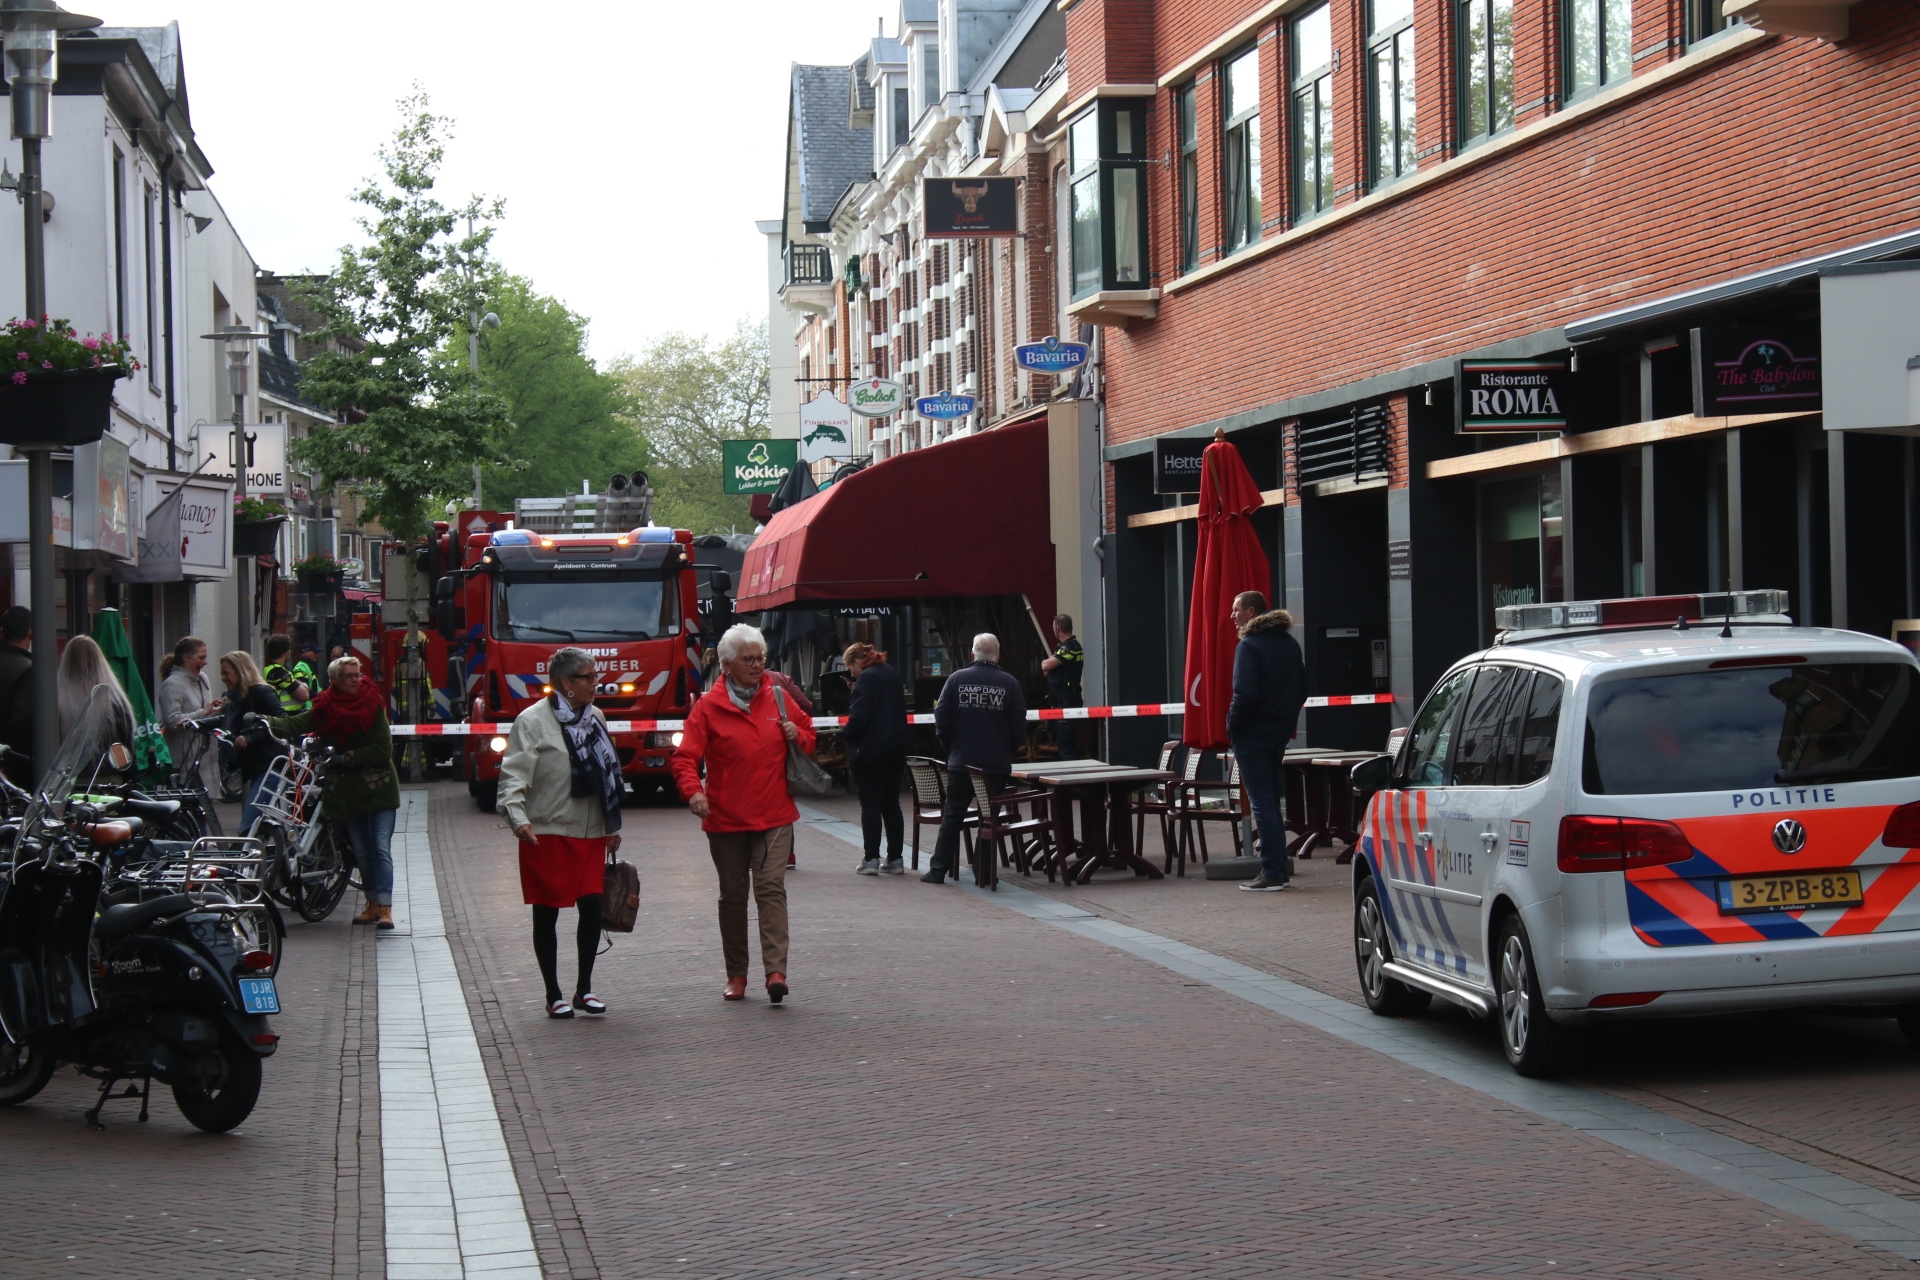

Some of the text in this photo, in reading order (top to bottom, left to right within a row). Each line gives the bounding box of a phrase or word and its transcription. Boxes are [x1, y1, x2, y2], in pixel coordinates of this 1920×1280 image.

[1026, 350, 1080, 364] Bavaria
[1480, 373, 1548, 386] Ristorante
[1718, 364, 1816, 388] The Babylon
[1760, 384, 1776, 392] Club
[855, 388, 896, 406] Grolsch
[1470, 388, 1561, 415] ROMA
[924, 401, 968, 413] Bavaria
[735, 464, 788, 481] Kokkie
[243, 473, 282, 487] HONE
[1493, 583, 1534, 607] Ristorante
[536, 660, 639, 673] BWEER
[959, 692, 1004, 706] CREW
[982, 687, 1006, 697] DAVID
[1732, 788, 1836, 808] POLITIE
[1742, 876, 1850, 904] 3-ZPB-83
[251, 982, 272, 994] DJR
[255, 997, 275, 1010] 81B
